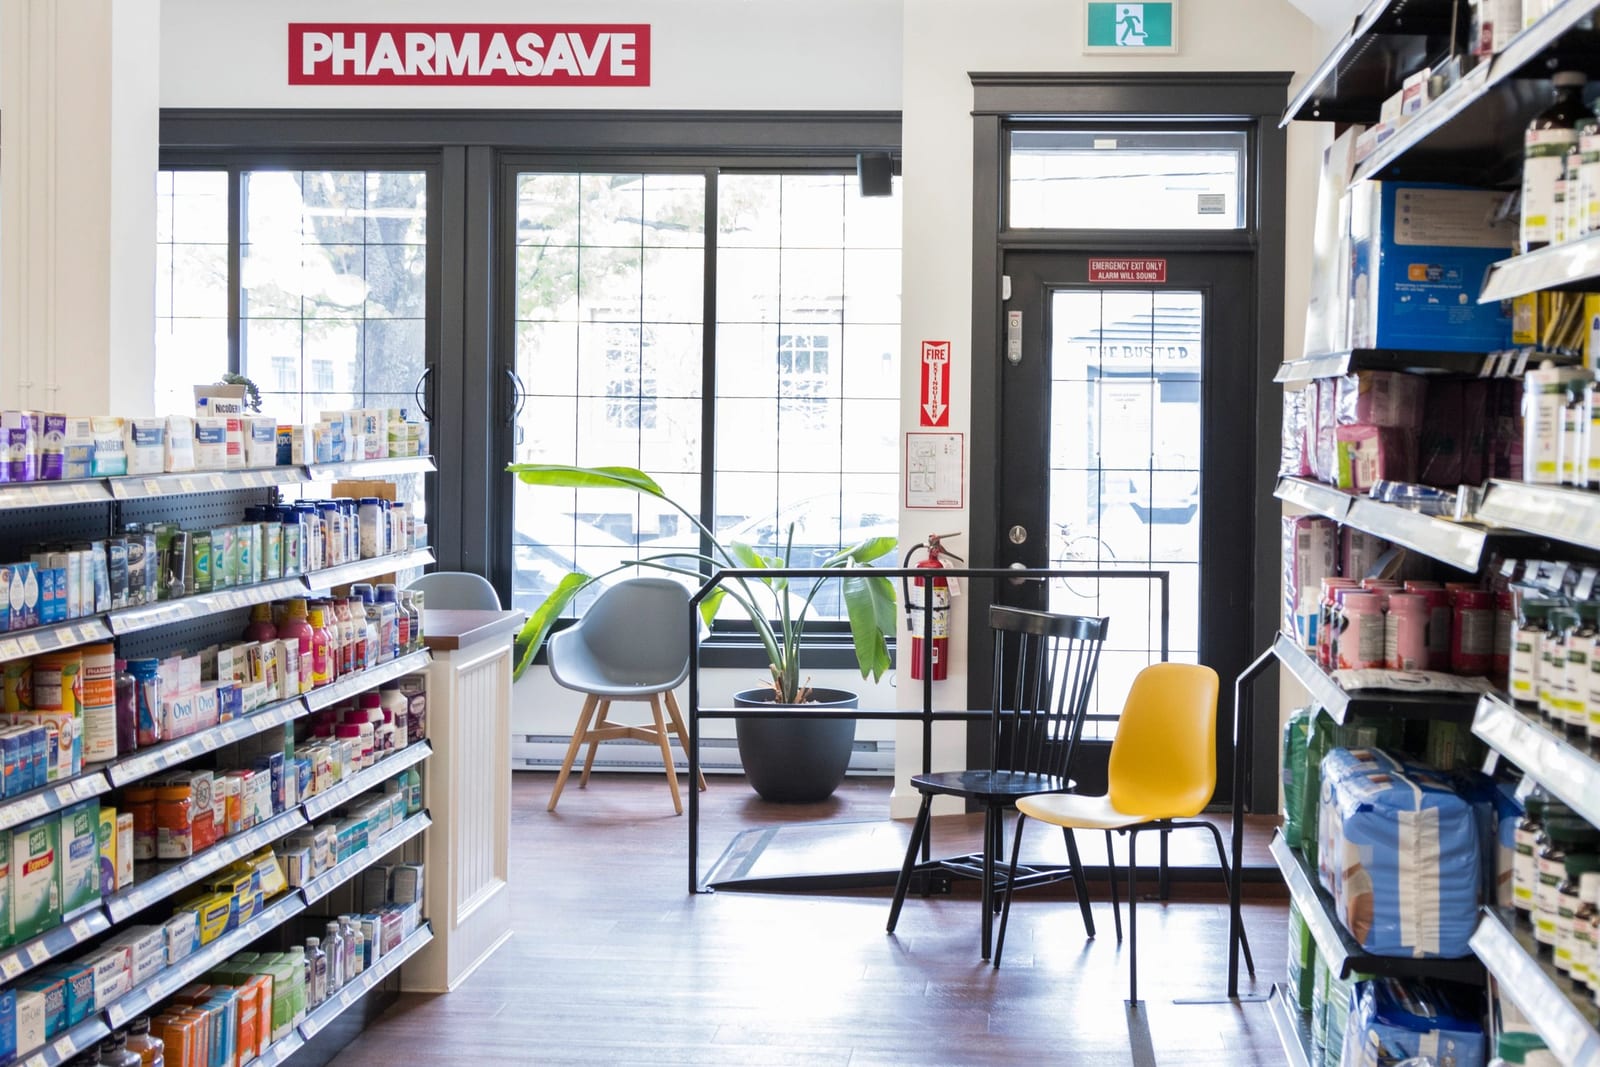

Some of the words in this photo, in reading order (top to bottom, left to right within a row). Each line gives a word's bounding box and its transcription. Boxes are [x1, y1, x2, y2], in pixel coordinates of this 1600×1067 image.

[302, 32, 636, 77] PHARMASAVE
[1092, 261, 1129, 271] EMERGENCY
[1130, 261, 1144, 271] EXIT
[1146, 261, 1162, 271] ONLY
[1098, 271, 1119, 280] ALARM
[1121, 271, 1135, 280] WILL
[1136, 271, 1157, 280] SOUND
[926, 349, 945, 360] FIRE
[1086, 346, 1118, 358] THE
[1122, 346, 1188, 359] BUSTED
[173, 699, 192, 718] Ovol
[198, 692, 215, 712] Ovol
